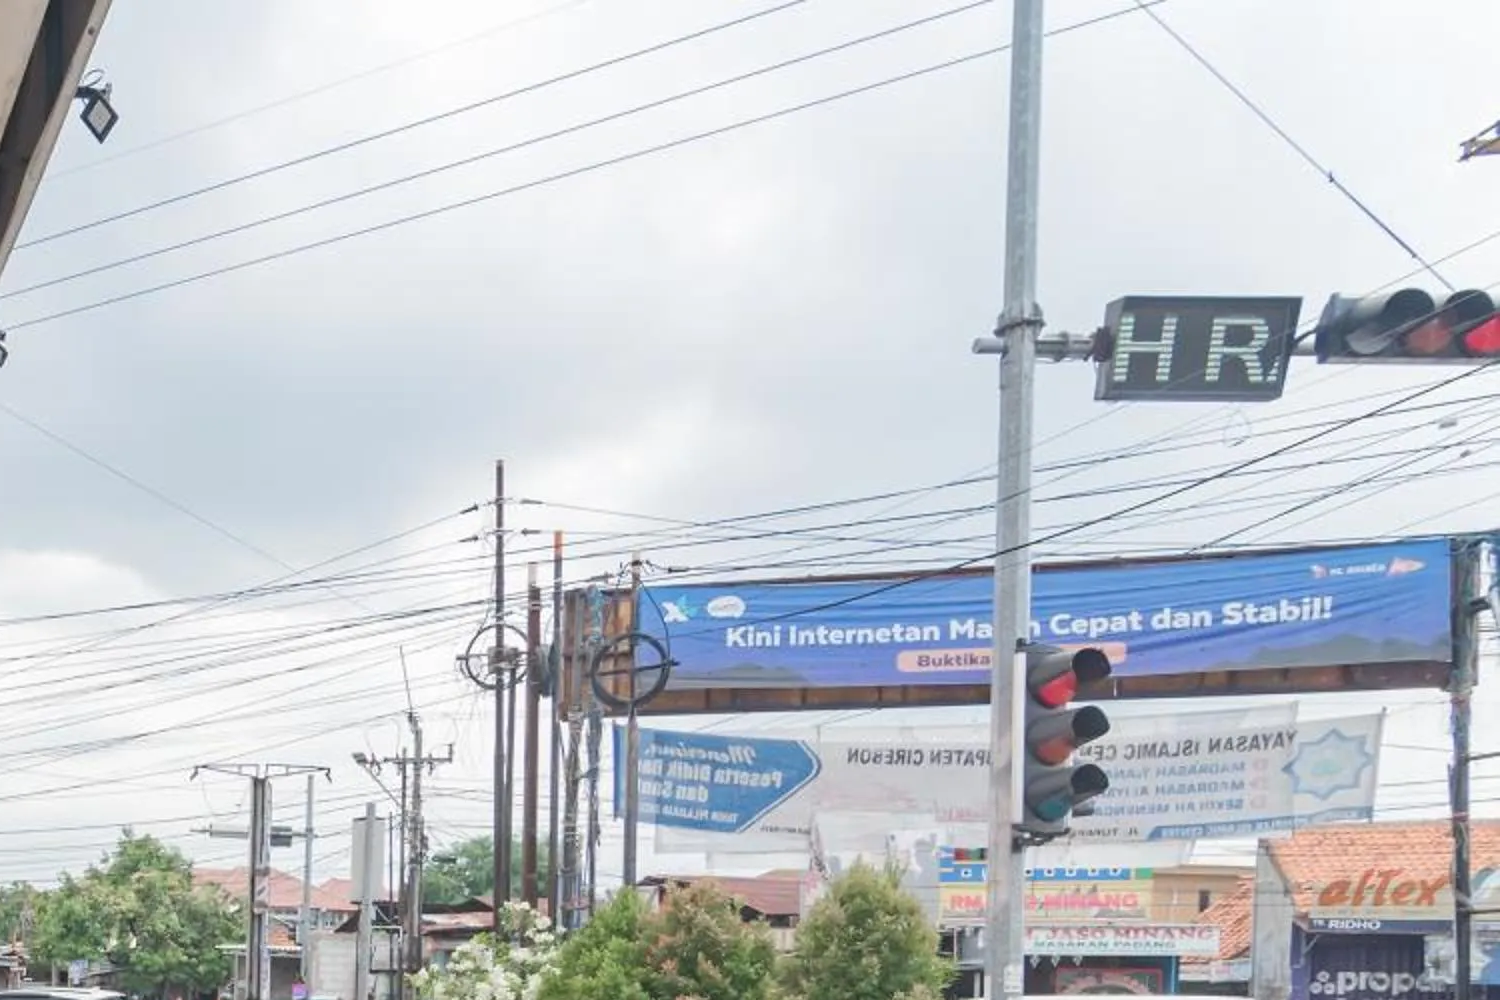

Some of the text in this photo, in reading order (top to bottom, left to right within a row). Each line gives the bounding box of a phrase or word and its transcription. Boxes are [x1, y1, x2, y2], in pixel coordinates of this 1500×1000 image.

[726, 594, 1333, 649] Kini Internetan Man Cepat dan Stabil!
[917, 653, 992, 669] Buktika
[1114, 926, 1212, 940] MINANG
